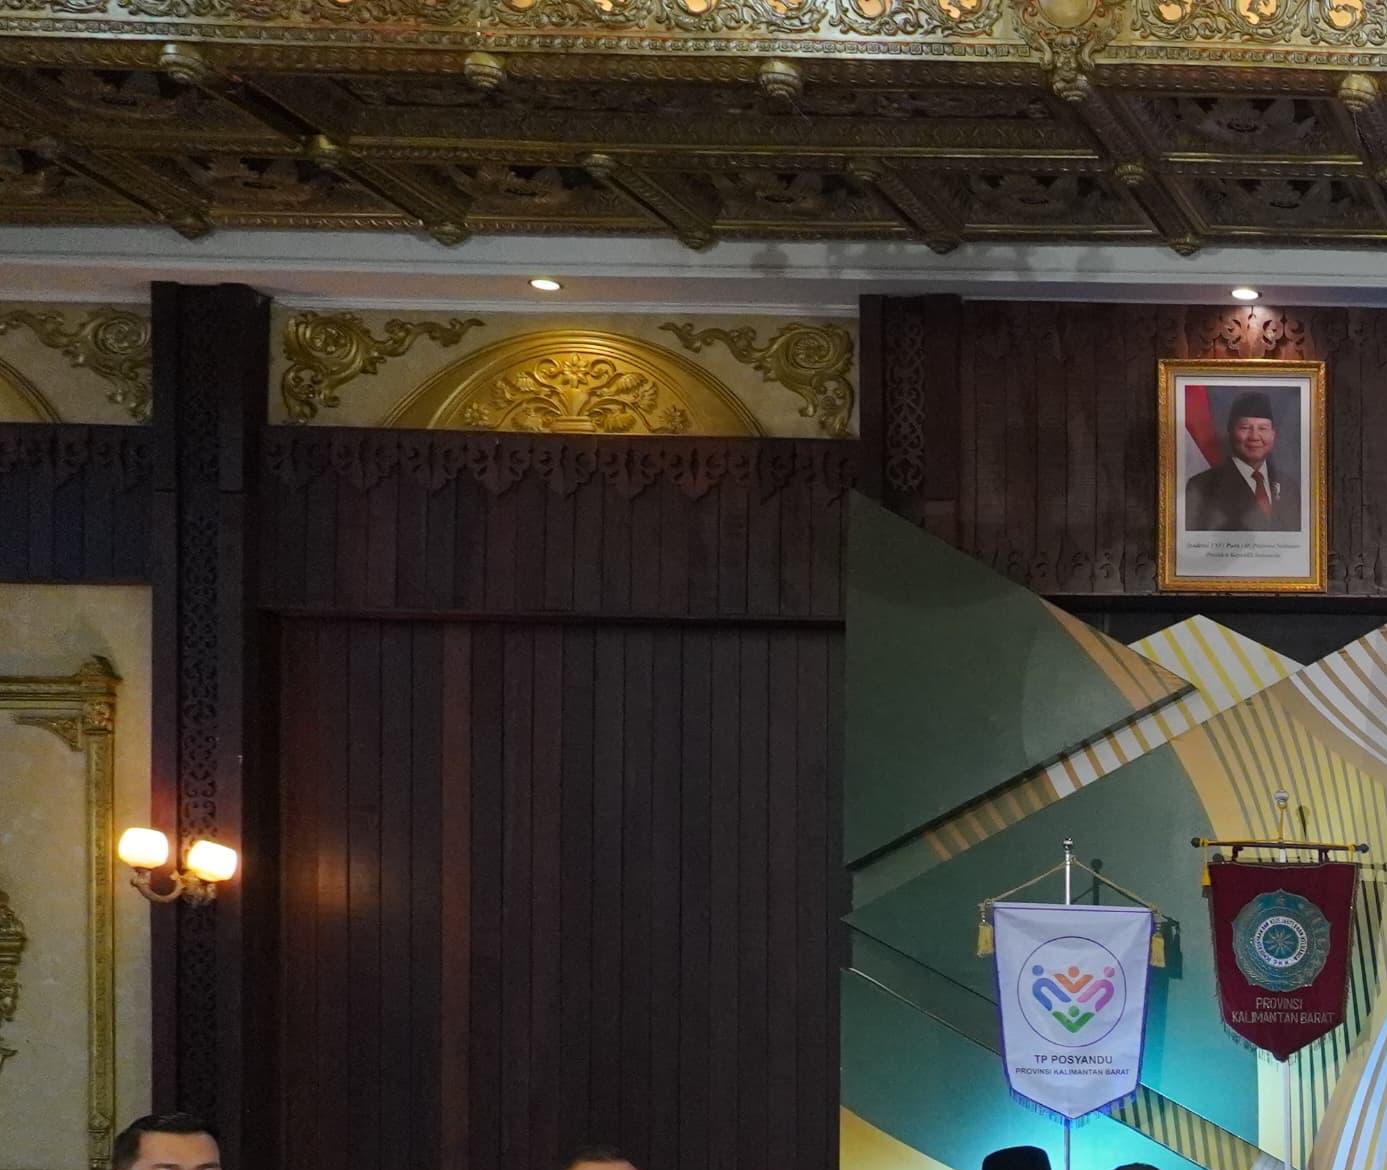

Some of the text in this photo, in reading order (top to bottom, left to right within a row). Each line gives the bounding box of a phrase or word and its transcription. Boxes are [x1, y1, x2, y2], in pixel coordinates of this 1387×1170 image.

[1255, 997, 1303, 1010] PROVINSI
[1231, 1011, 1336, 1024] KALIMANTAN BARAT
[1034, 1054, 1113, 1065] TP POSYANDU
[1015, 1067, 1129, 1076] PROVINSI KALIMANTAN BARAT
